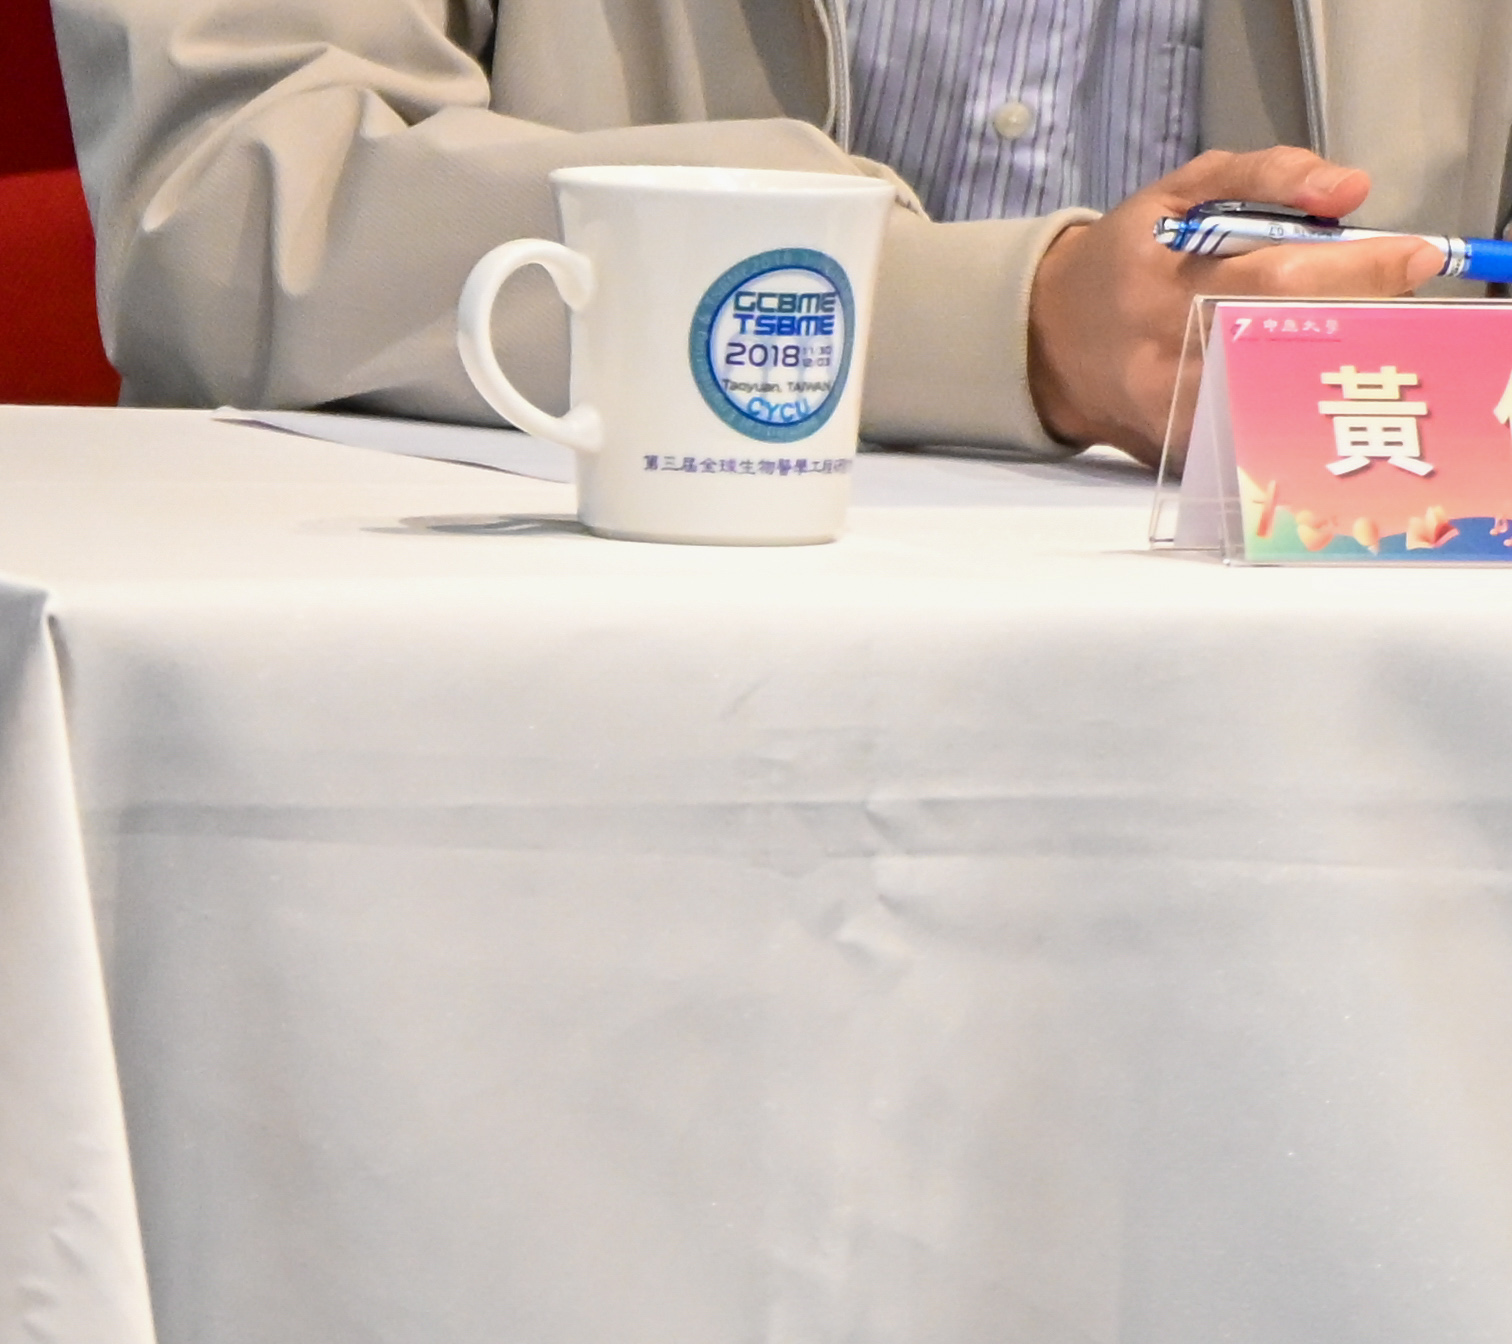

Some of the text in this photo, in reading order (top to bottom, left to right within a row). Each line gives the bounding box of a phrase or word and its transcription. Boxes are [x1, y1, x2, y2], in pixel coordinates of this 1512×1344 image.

[733, 291, 837, 313] GCBME
[733, 313, 836, 336] TSBME
[725, 342, 801, 367] 2018
